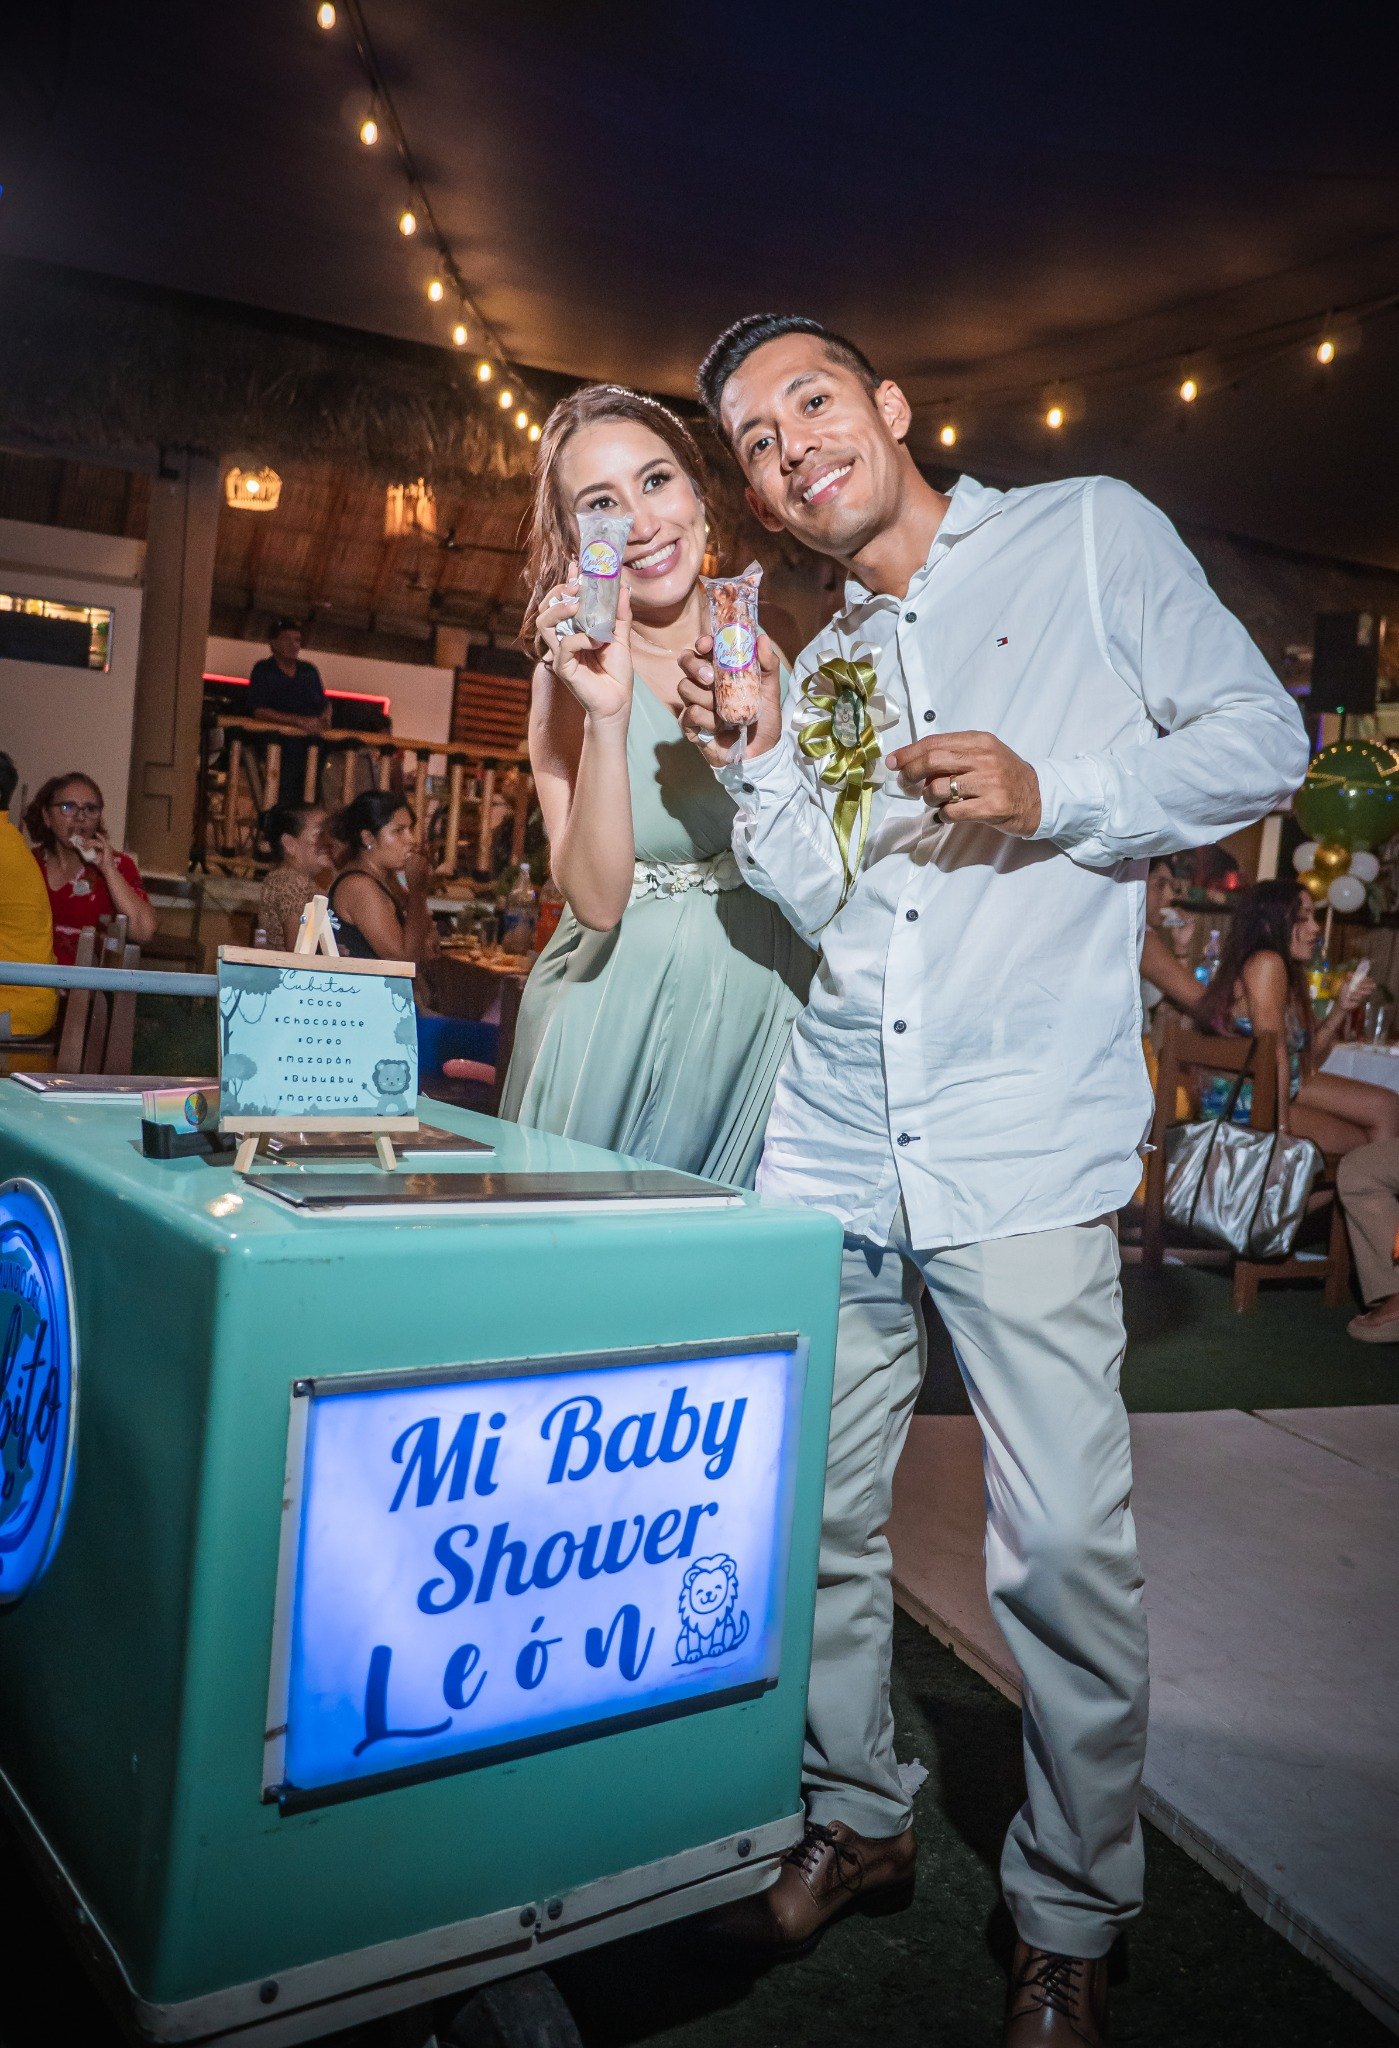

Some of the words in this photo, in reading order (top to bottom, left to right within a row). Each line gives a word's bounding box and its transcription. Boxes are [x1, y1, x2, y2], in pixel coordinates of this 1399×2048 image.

[282, 969, 361, 994] Cubitos
[389, 1410, 506, 1513] Mi
[541, 1386, 749, 1484] Baby
[416, 1500, 719, 1615] Shower
[353, 1602, 656, 1758] León
